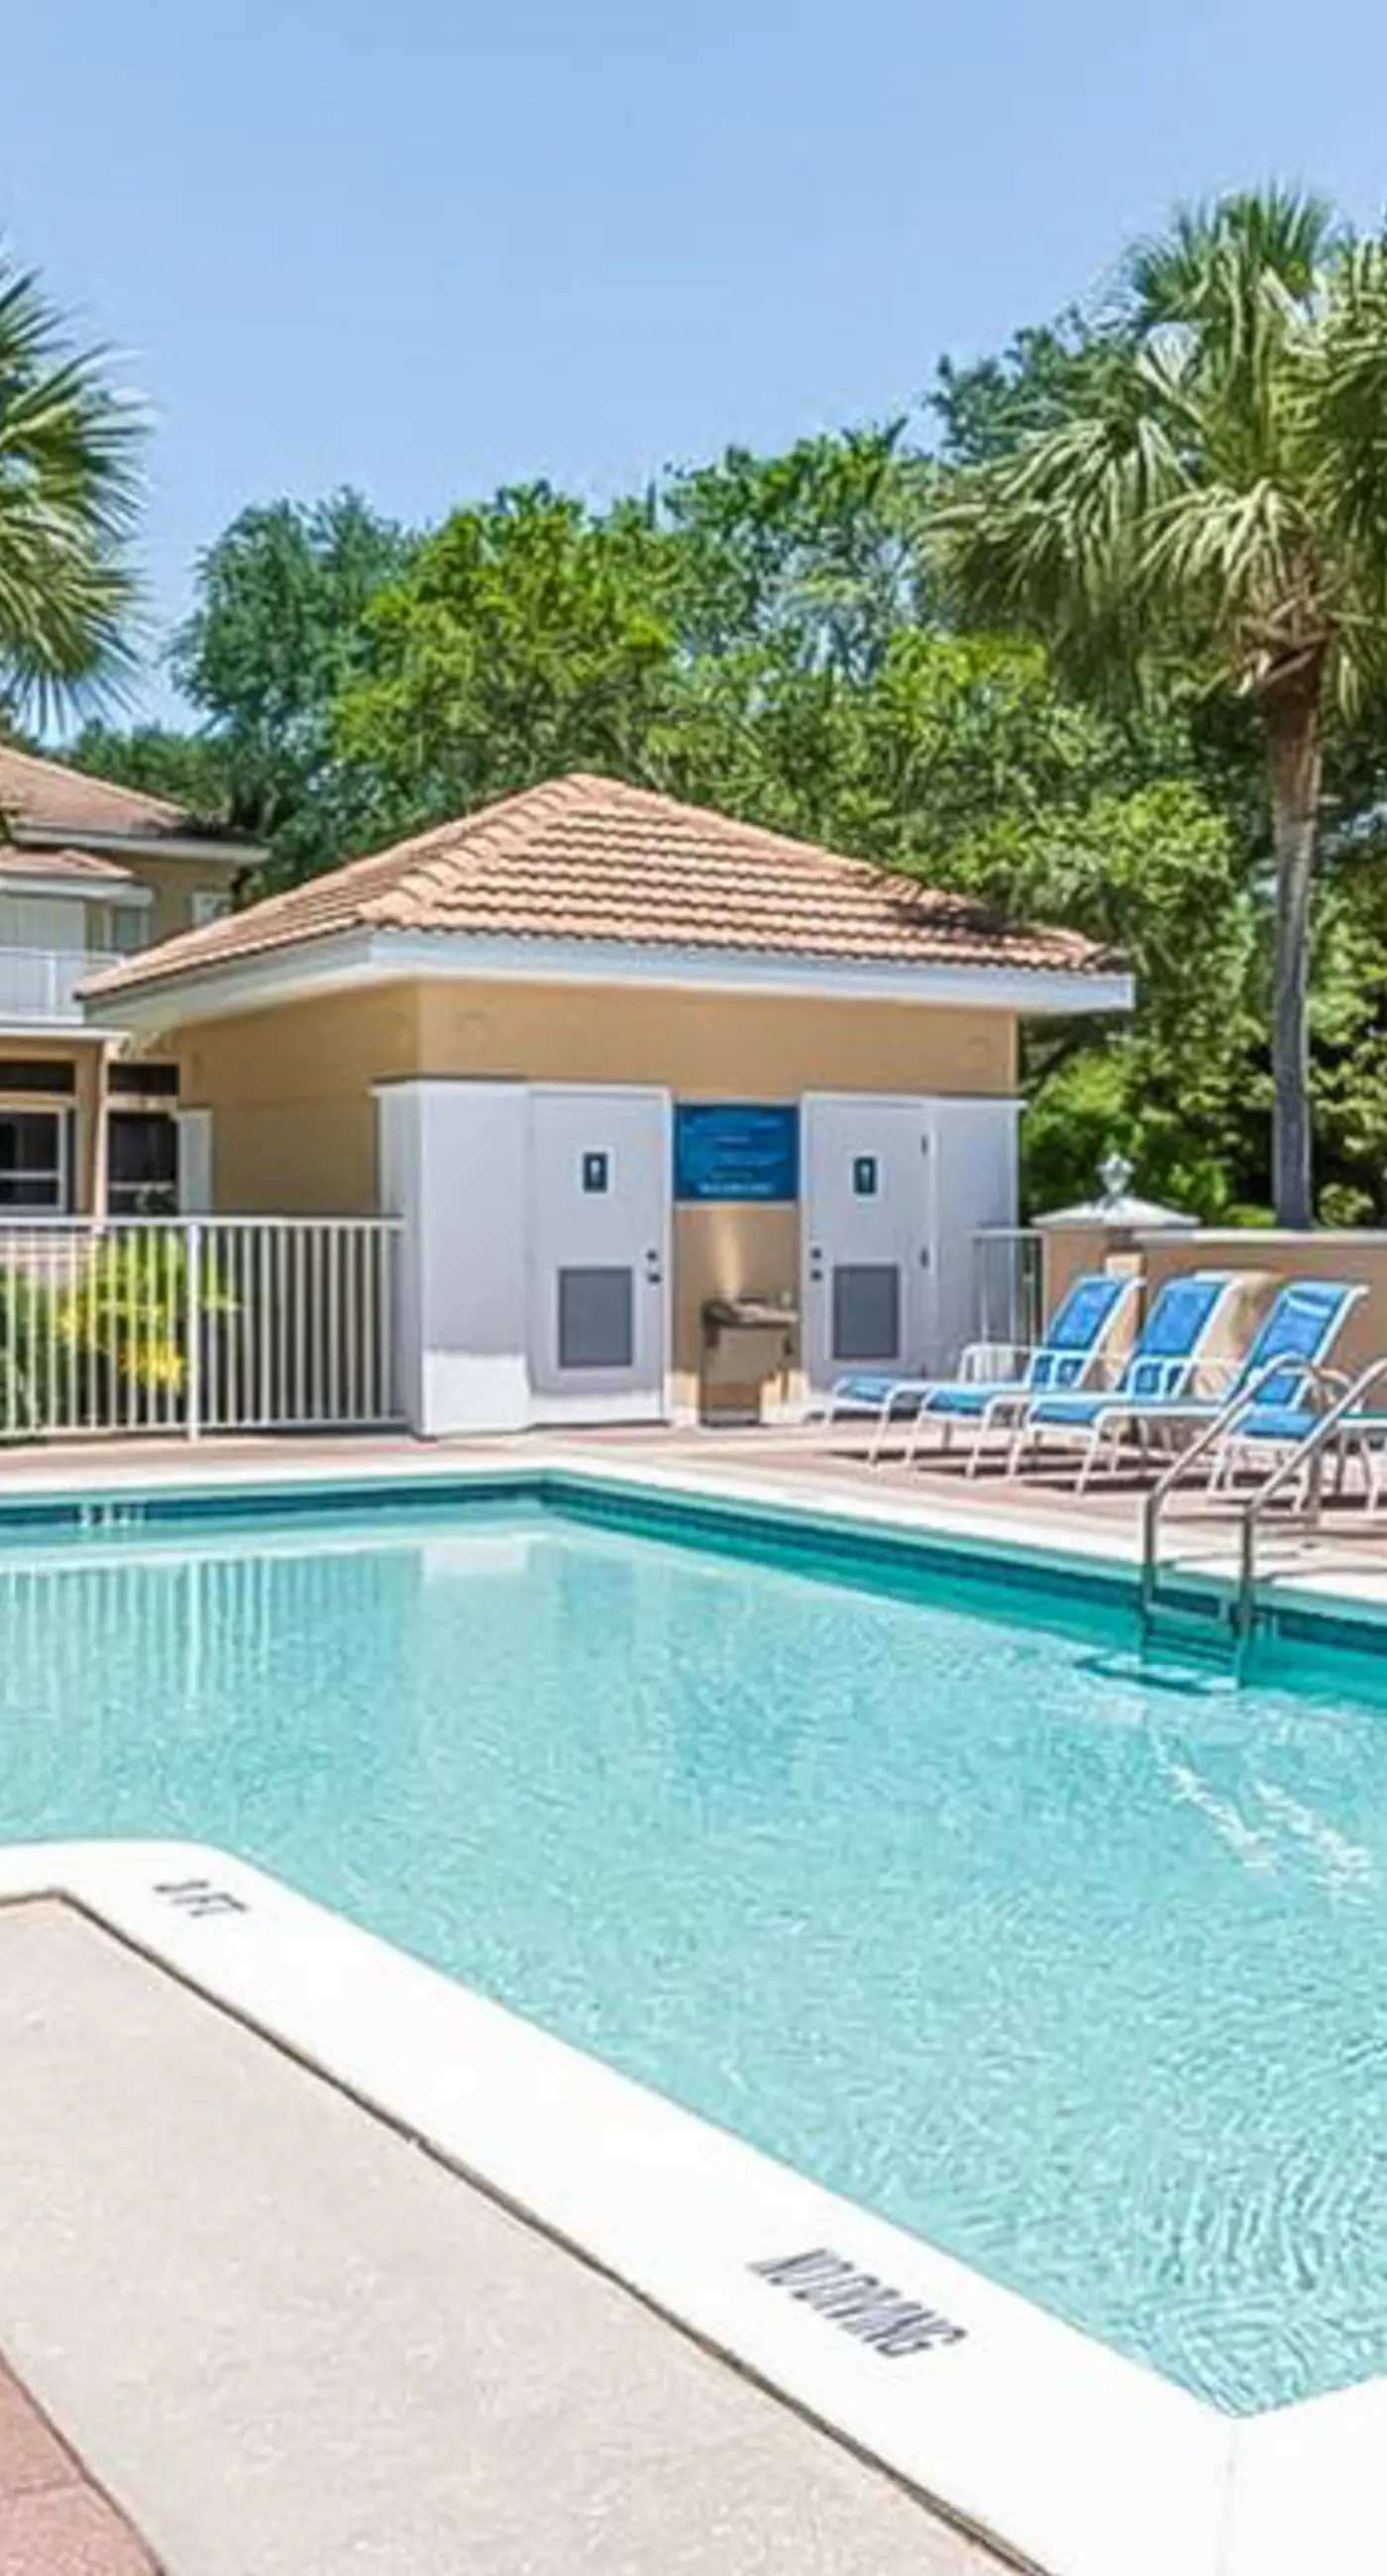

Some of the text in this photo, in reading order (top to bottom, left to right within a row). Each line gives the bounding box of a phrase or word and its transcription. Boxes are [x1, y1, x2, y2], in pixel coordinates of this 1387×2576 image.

[172, 1891, 251, 1918] FT
[746, 2247, 970, 2359] NO DIVING
